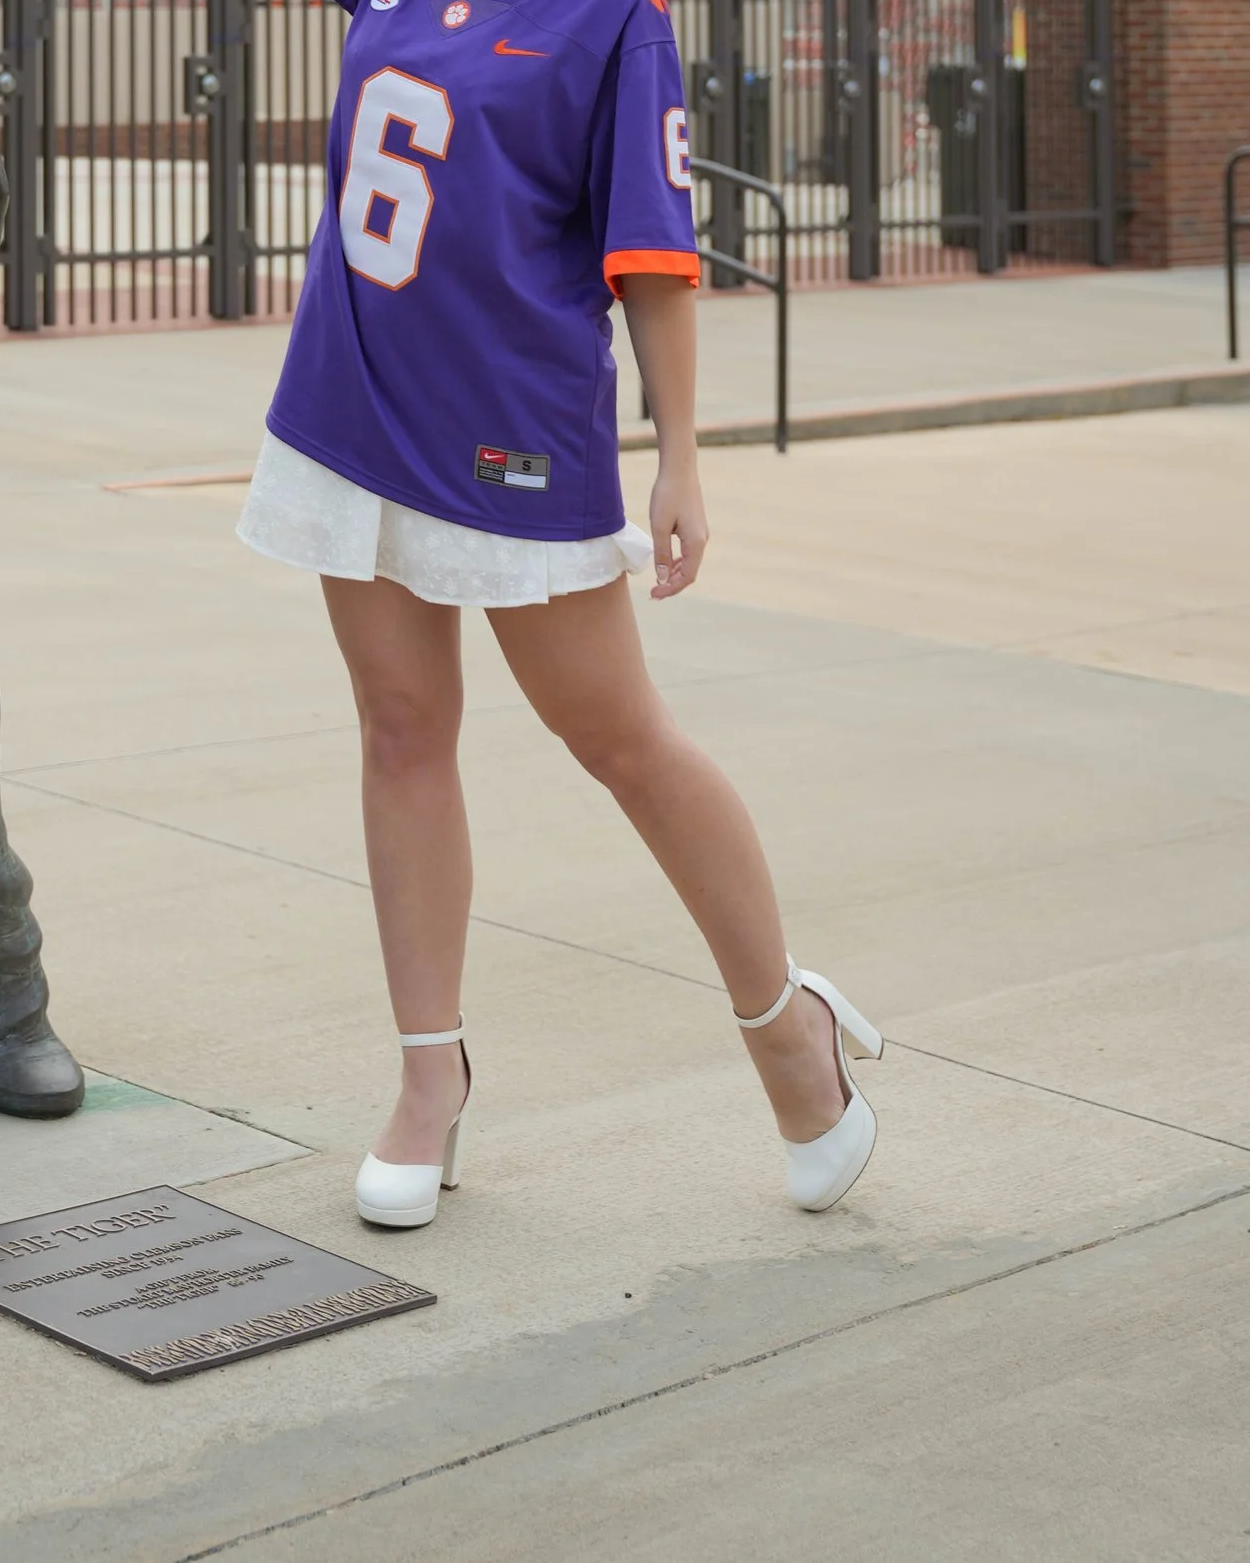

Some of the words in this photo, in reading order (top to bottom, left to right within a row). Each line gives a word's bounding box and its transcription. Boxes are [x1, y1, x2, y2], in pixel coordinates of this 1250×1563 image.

[340, 66, 455, 291] 6
[521, 460, 532, 472] S
[3, 1254, 131, 1292] ENTERTAINING
[130, 1237, 205, 1261] CLEMSON
[205, 1228, 243, 1244] FANS
[101, 1260, 152, 1279] SINCE
[151, 1254, 184, 1267] 1954
